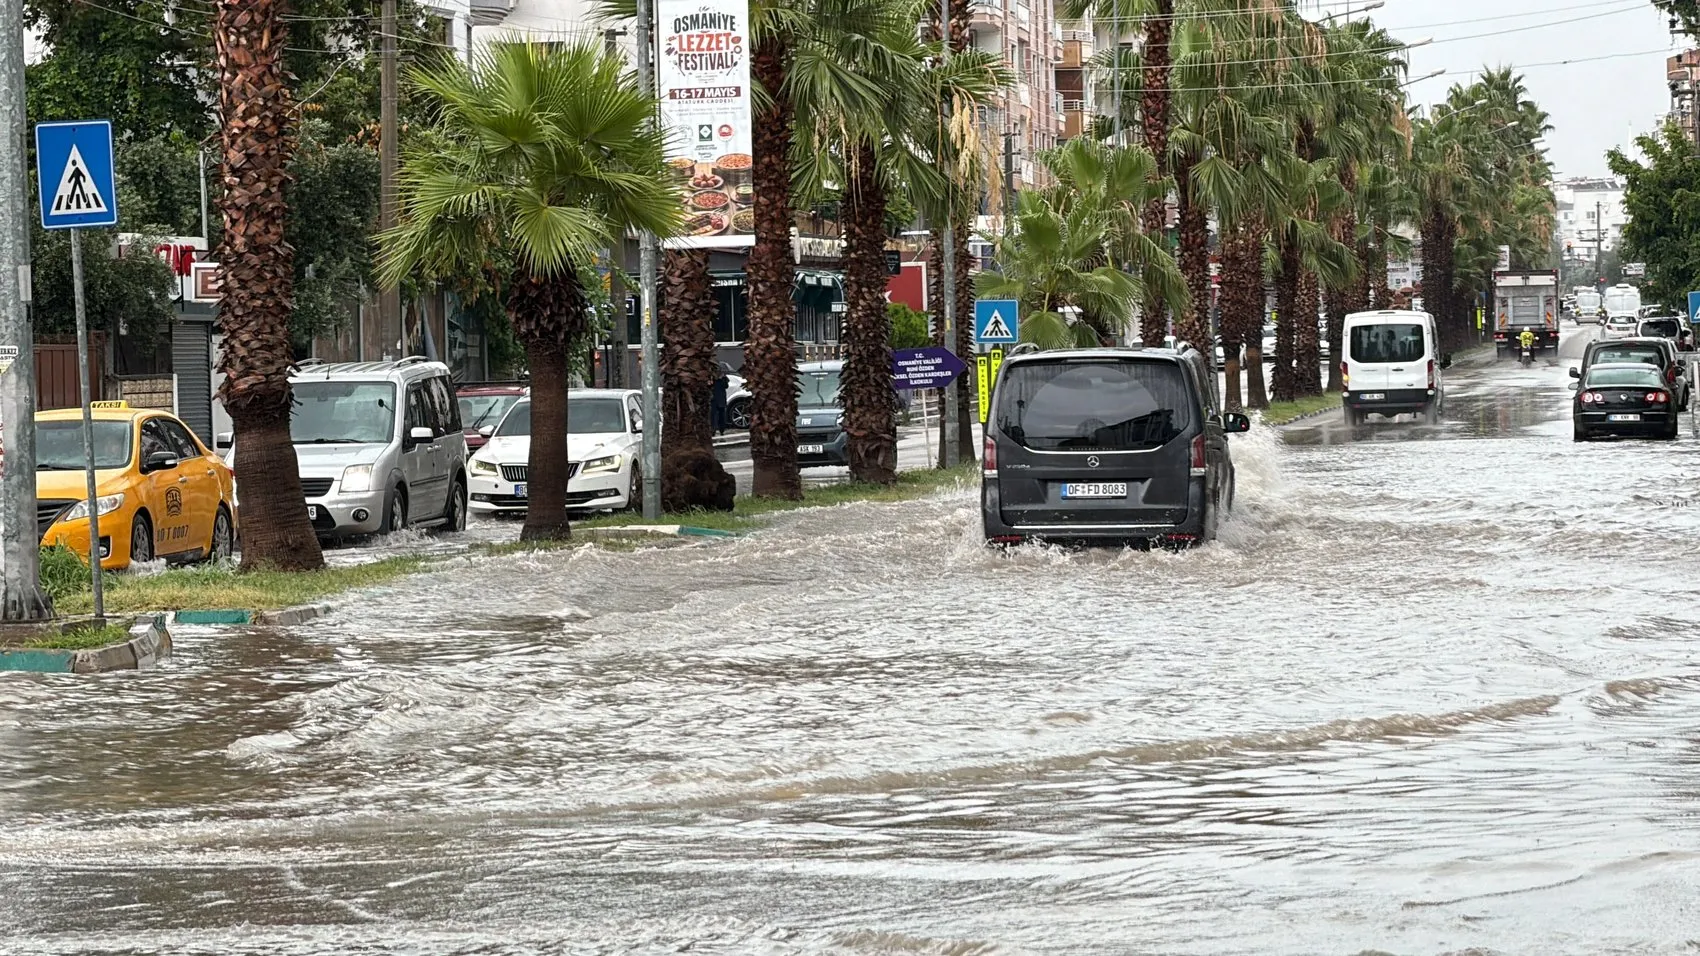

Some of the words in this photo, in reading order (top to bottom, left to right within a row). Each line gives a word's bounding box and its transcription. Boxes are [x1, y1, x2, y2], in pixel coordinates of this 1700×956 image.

[674, 12, 736, 33] OSMANİYE
[678, 33, 732, 52] LEZZET
[678, 51, 734, 71] FESTİVALİ
[675, 89, 703, 99] 16-17
[704, 87, 736, 98] MAYIS
[1068, 484, 1081, 495] OF
[1087, 484, 1100, 495] FD
[1102, 484, 1126, 495] 8083
